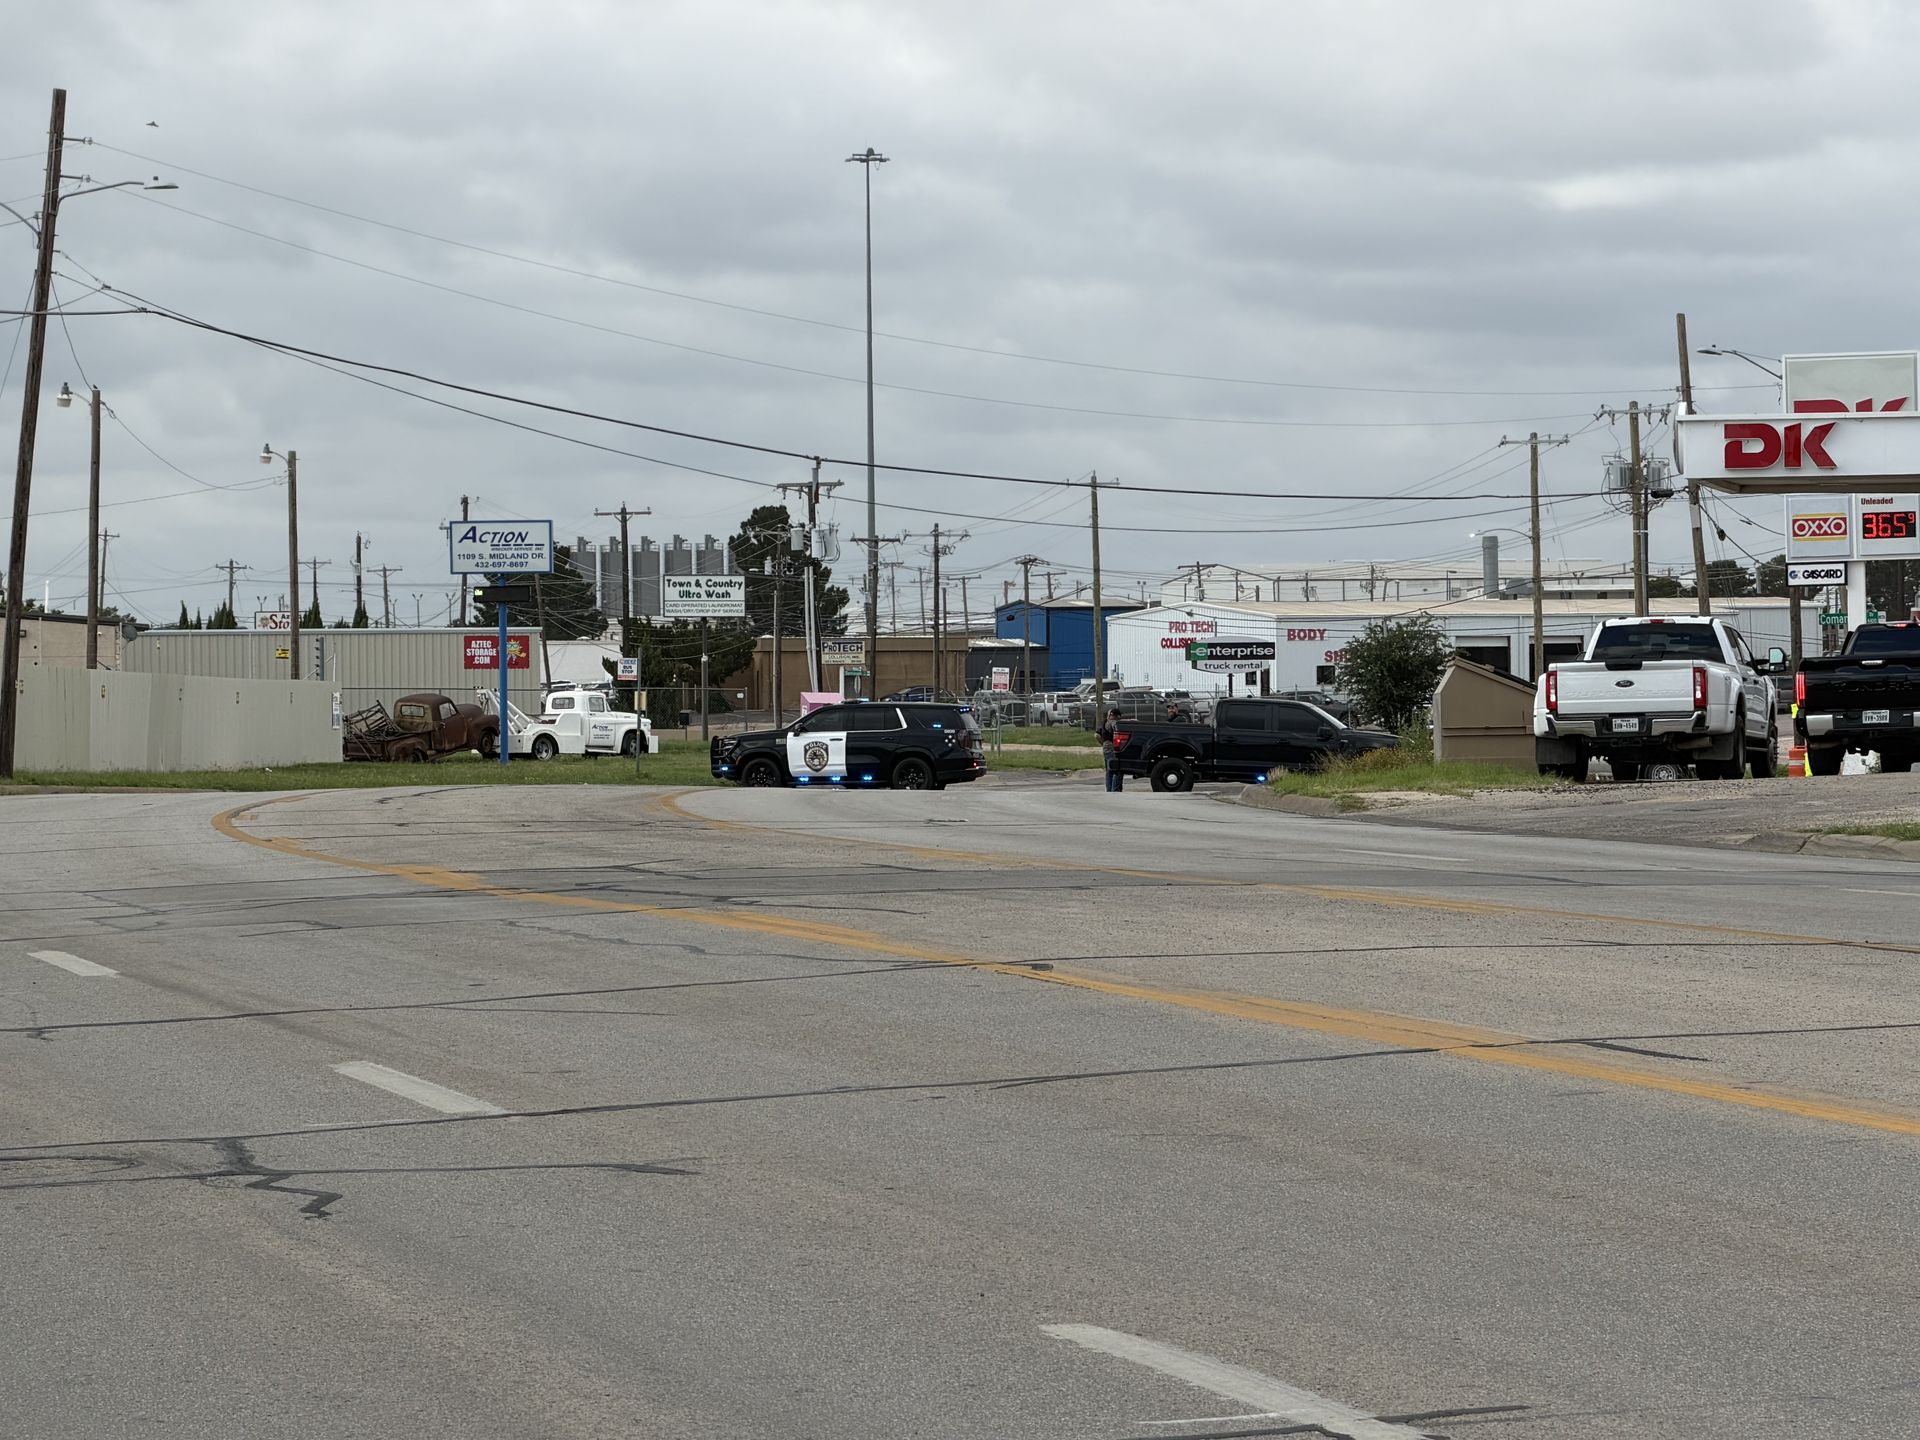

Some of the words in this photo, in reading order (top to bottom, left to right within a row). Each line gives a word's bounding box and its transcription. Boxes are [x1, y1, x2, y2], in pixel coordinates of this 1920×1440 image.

[1724, 422, 1838, 470] DK
[1861, 497, 1893, 505] Unleaded
[1793, 517, 1846, 537] OXXO
[458, 525, 529, 543] ACTION
[489, 552, 529, 560] MIDLAND
[1802, 569, 1843, 579] GASCARD
[666, 579, 692, 588] Town
[695, 579, 702, 588] &
[705, 579, 743, 590] Country
[679, 590, 702, 599] Ultra
[705, 590, 731, 599] Wash
[1169, 621, 1187, 633] PRO
[1190, 621, 1214, 633] TECH
[1287, 628, 1327, 641] BODY
[471, 640, 492, 648] AZTEC
[466, 648, 497, 656] STORAGE
[1191, 645, 1274, 658] enterprise
[473, 656, 490, 664] .COM
[1204, 662, 1231, 670] truck
[1233, 661, 1263, 669] rental
[805, 742, 827, 750] POLICE
